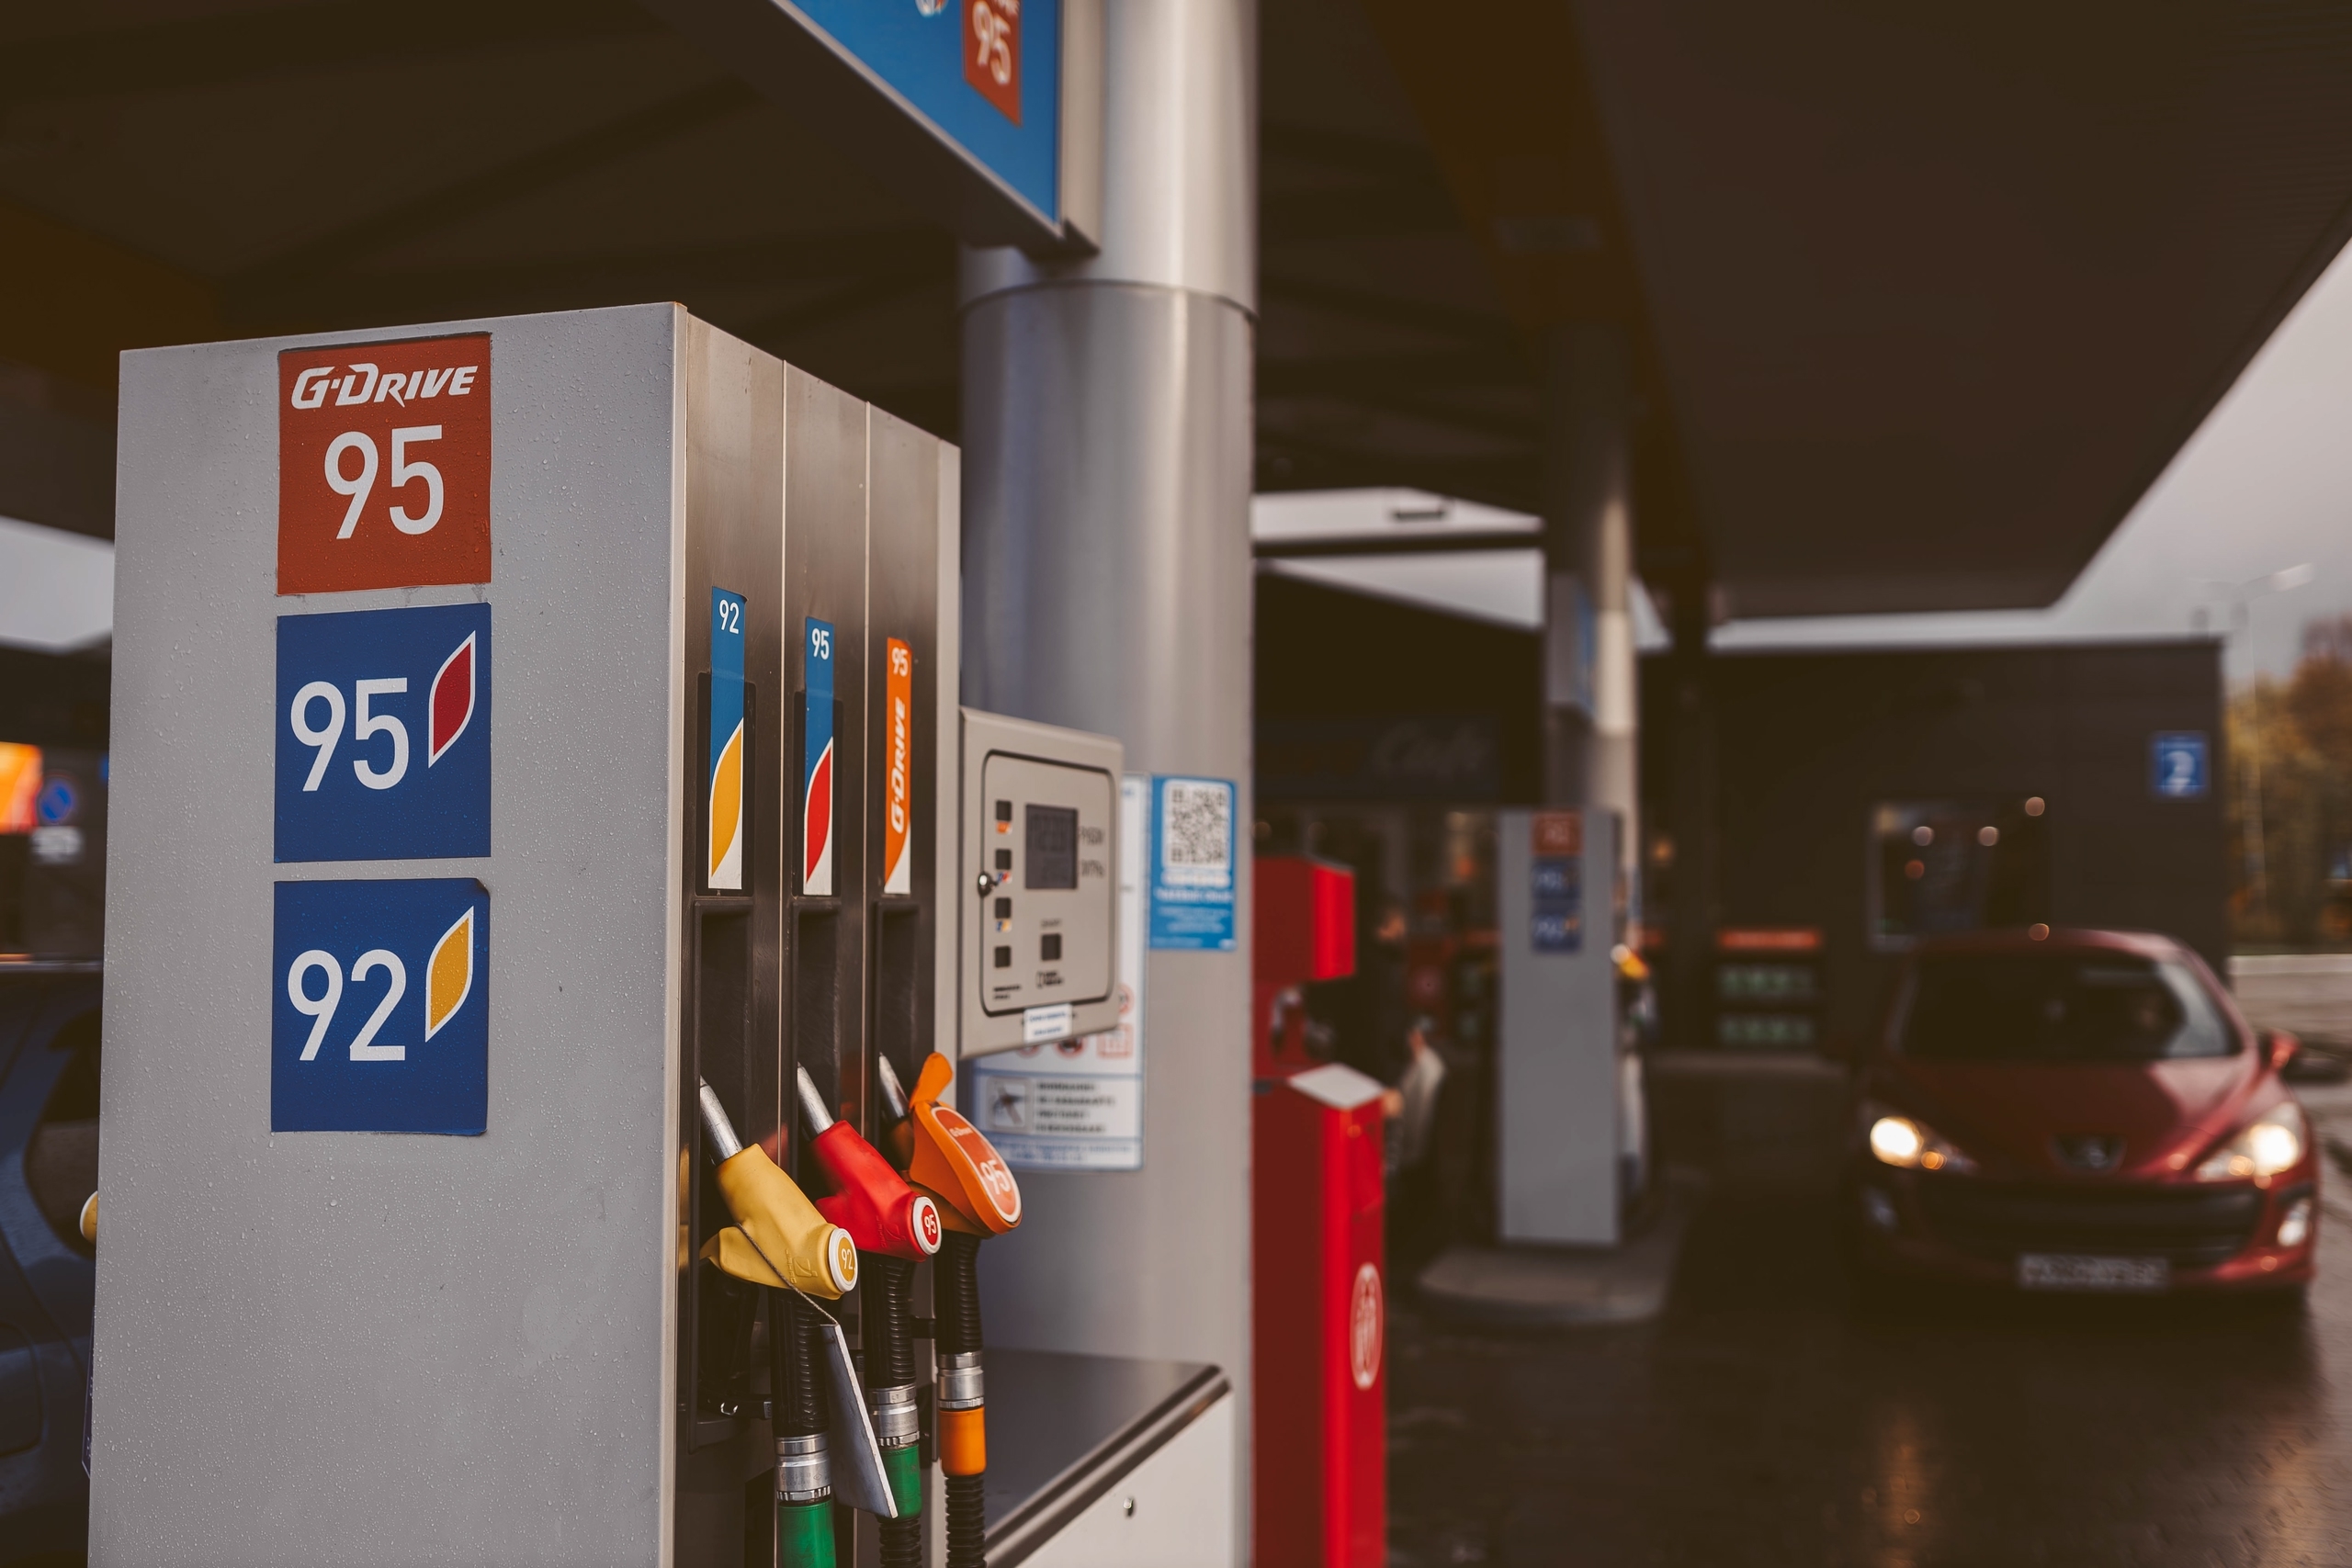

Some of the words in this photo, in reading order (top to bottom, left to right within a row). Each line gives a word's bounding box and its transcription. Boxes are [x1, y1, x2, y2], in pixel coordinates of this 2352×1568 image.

[971, 1, 1012, 85] 95
[324, 424, 445, 540] 95
[718, 599, 741, 635] 92
[811, 627, 831, 660] 95
[891, 647, 909, 678] 95
[290, 677, 410, 793] 95
[288, 949, 407, 1063] 92
[979, 1159, 1012, 1195] 95
[923, 1213, 937, 1236] 95
[841, 1247, 854, 1270] 92
